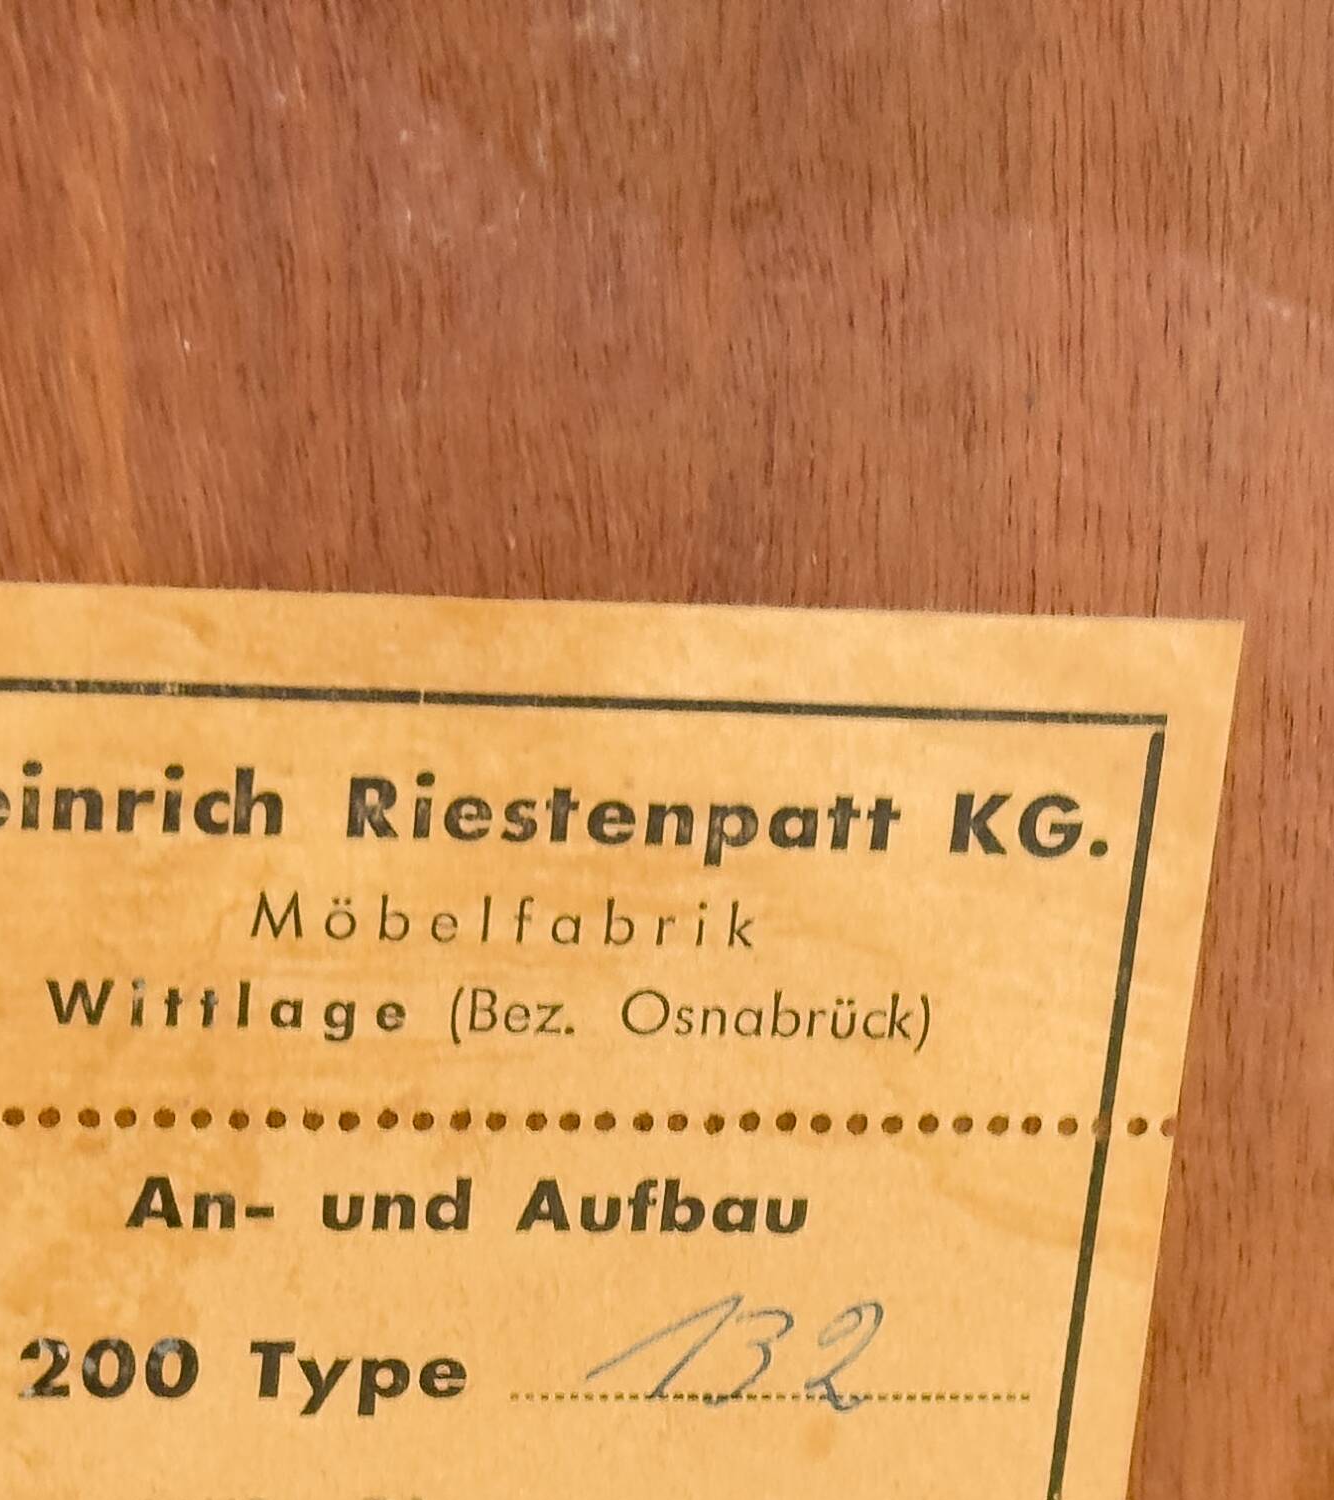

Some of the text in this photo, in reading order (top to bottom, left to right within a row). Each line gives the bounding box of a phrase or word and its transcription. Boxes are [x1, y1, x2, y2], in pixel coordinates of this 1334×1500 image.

[346, 772, 901, 868] Riestenpatt
[948, 792, 1110, 858] KG.
[250, 890, 756, 947] Möbelfabrik
[46, 977, 932, 1053] Wittlage (Bez. Osnabrück)
[125, 1175, 809, 1234] An- und Aufbau
[17, 1336, 200, 1400] 200
[250, 1340, 468, 1417] Type
[585, 1292, 885, 1413] 132
